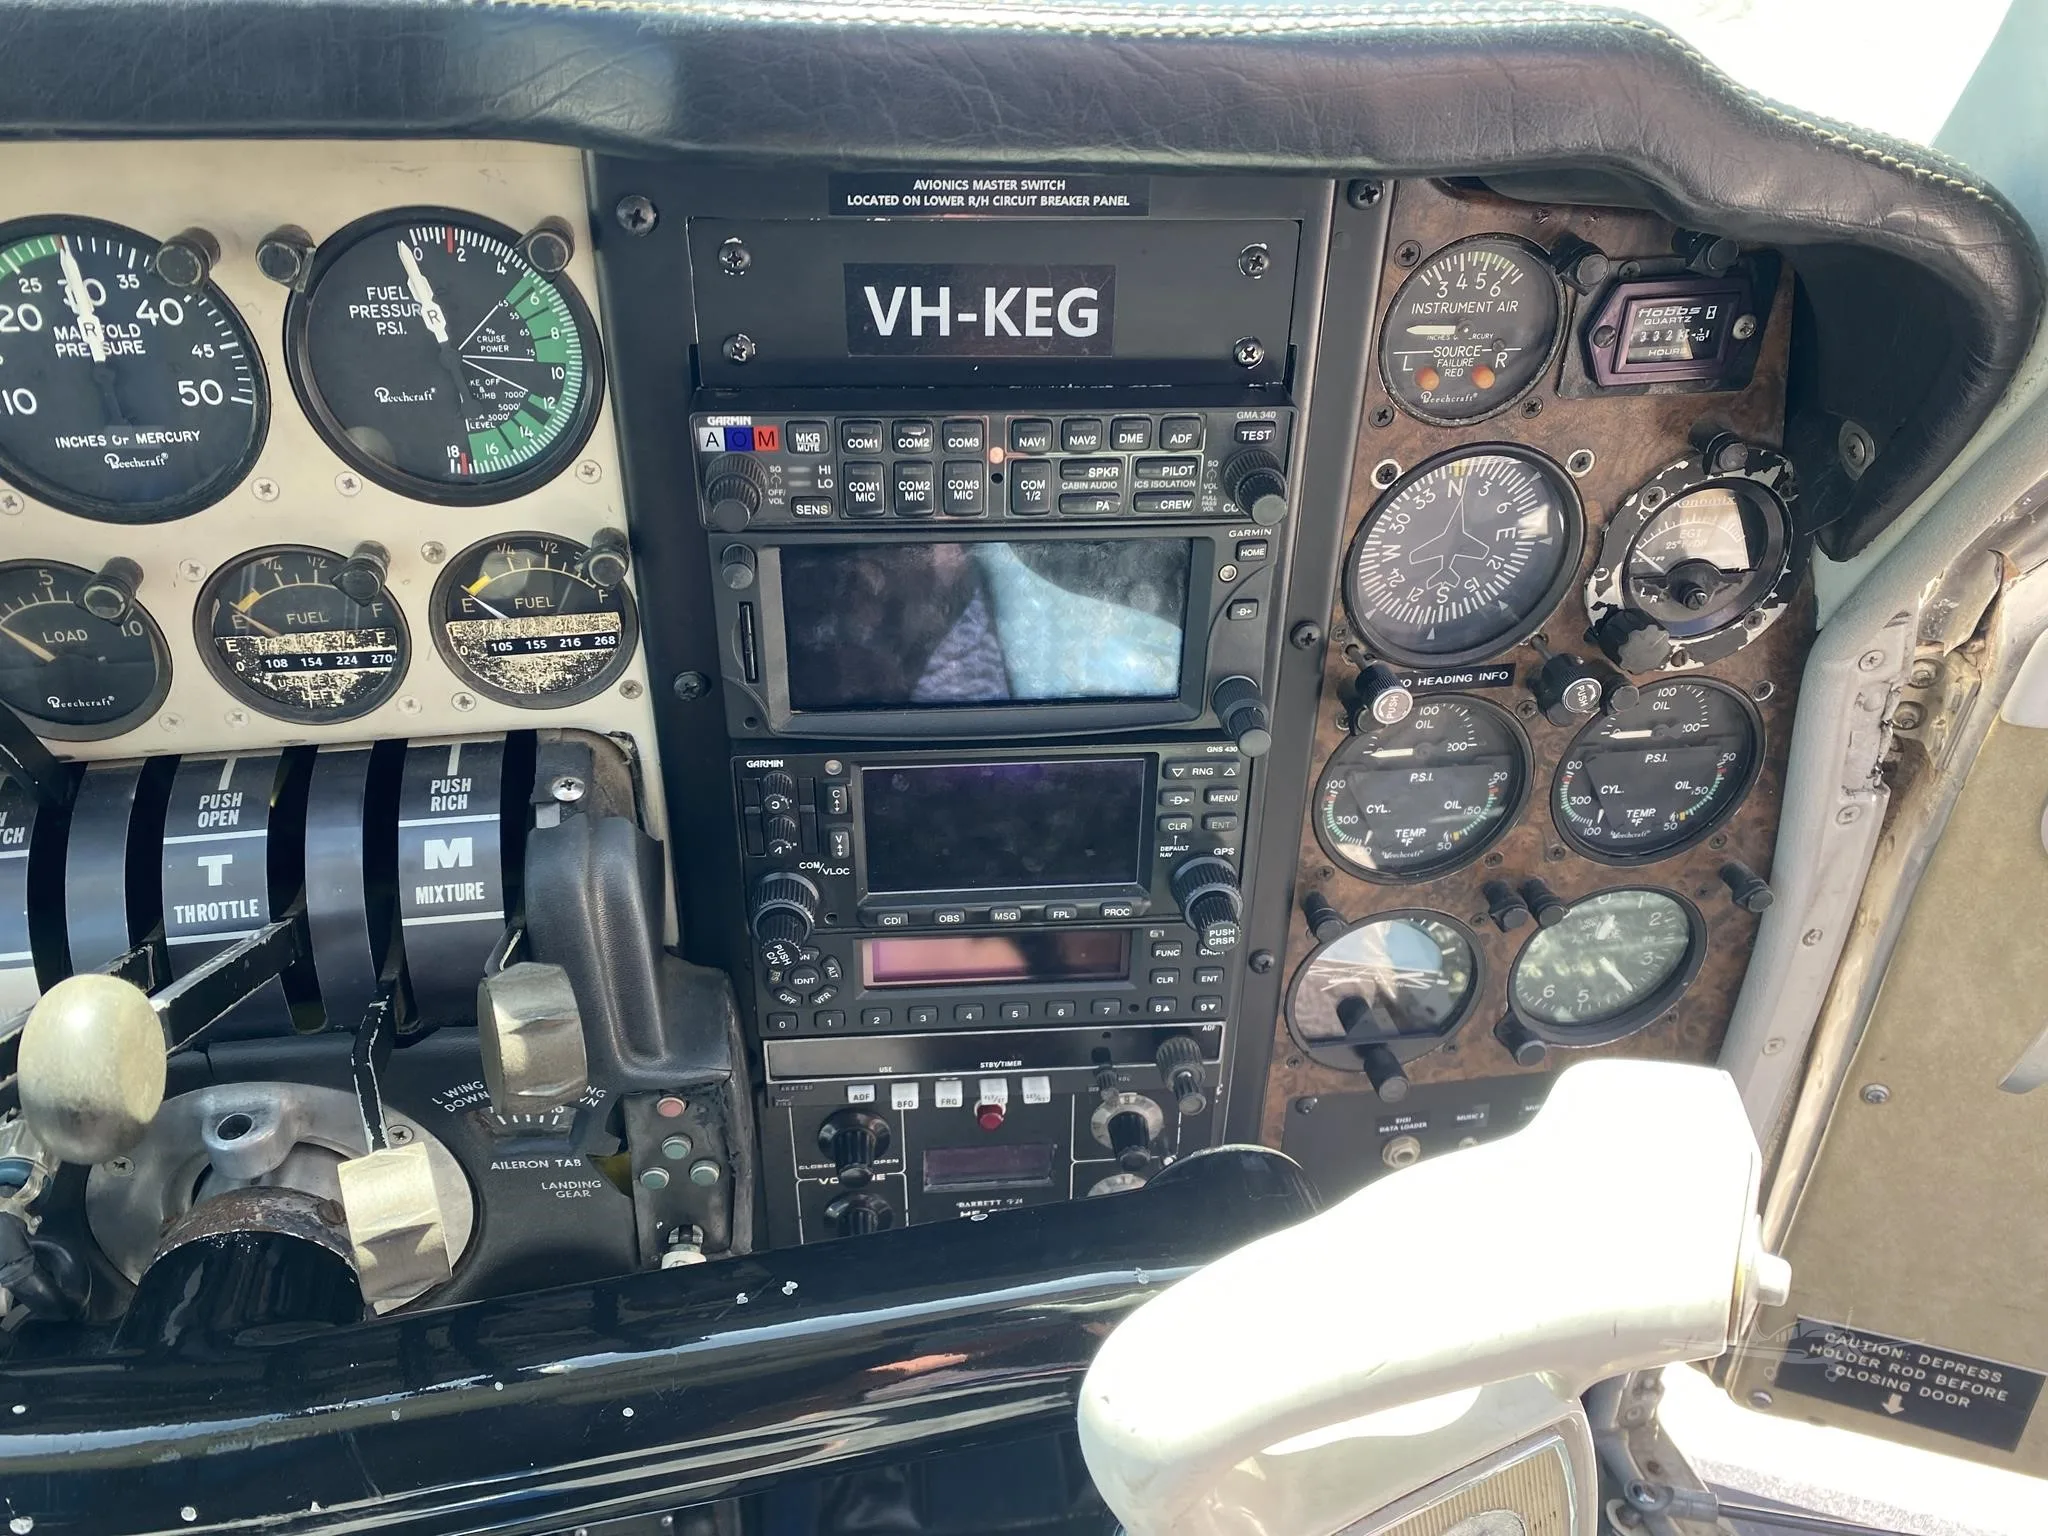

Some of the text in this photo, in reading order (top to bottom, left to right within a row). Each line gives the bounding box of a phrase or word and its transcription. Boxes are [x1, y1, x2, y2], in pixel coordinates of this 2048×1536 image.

[913, 180, 1066, 191] AVIONICS MASTER SWITCH
[847, 195, 1130, 208] LOCATED ON LOWER R/H CIRCUIT BREAKER PANEL
[19, 278, 42, 293] 25
[117, 275, 139, 288] 35
[367, 286, 409, 300] FUEL
[136, 298, 184, 326] 40
[864, 286, 1098, 338] VH-KEG
[1412, 301, 1518, 314] INSTRUMENT AIR
[1639, 306, 1701, 318] Hobbs
[1644, 316, 1692, 325] QUARTZ
[377, 323, 407, 335] P.S.I.
[55, 340, 146, 358] PRESURE
[192, 344, 214, 358] 45
[1433, 346, 1482, 358] SOURCE
[1403, 356, 1413, 371] L
[1437, 358, 1474, 367] FAILURE
[1495, 352, 1507, 368] R
[551, 367, 564, 380] 10
[1445, 369, 1463, 377] RED
[178, 379, 223, 406] 50
[2, 388, 37, 415] 10
[707, 416, 751, 426] GARMIN
[55, 435, 106, 448] INCHES
[136, 431, 201, 444] MERCURY
[706, 433, 774, 447] A O M
[796, 433, 820, 444] MKR
[1069, 436, 1097, 445] NAV2
[1119, 434, 1143, 443] DME
[1170, 434, 1192, 444] ADF
[1241, 430, 1271, 440] TEST
[797, 443, 820, 451] MUTE
[847, 439, 878, 448] COM1
[898, 439, 929, 448] COM2
[948, 438, 979, 447] COM3
[1019, 437, 1046, 447] NAV1
[818, 465, 830, 474] HI
[1088, 467, 1118, 478] SPKR
[1162, 465, 1195, 476] PILOT
[818, 479, 833, 489] LO
[849, 482, 880, 492] COM1
[898, 481, 930, 491] COM2
[948, 480, 979, 490] COM3
[1021, 480, 1045, 490] COM
[1062, 481, 1117, 489] CABIN AUDIO
[1135, 480, 1195, 488] ICS ISOLATION
[1448, 479, 1464, 497] N
[856, 492, 876, 502] MIC
[905, 491, 925, 501] MIC
[954, 490, 973, 500] MIC
[1025, 490, 1041, 501] 1/2
[1413, 489, 1435, 510] 33
[796, 505, 828, 515] SENS
[1096, 501, 1110, 511] PA
[1160, 500, 1192, 510] CREW
[1229, 528, 1272, 537] GARMIN
[1496, 527, 1517, 541] E
[1241, 548, 1265, 556] HOME
[1487, 554, 1505, 570] 12
[515, 597, 555, 609] FUEL
[287, 611, 329, 625] FUEL
[43, 629, 88, 643] LOAD
[460, 636, 616, 655] 0 105 155 216 268
[265, 658, 288, 668] 108
[301, 658, 323, 667] 154
[336, 656, 357, 666] 224
[371, 654, 393, 664] 270
[1653, 702, 1670, 710] OIL
[1415, 721, 1434, 729] OIL
[746, 760, 783, 768] GARMIN
[431, 778, 471, 794] PUSH
[1675, 781, 1691, 790] OIL
[199, 792, 243, 810] PUSH
[431, 794, 467, 811] RICH
[1444, 801, 1462, 809] OIL
[1570, 796, 1591, 805] 300
[198, 809, 239, 828] OPEN
[1336, 816, 1358, 824] 300
[424, 837, 473, 870] M
[198, 854, 232, 886] T
[416, 882, 485, 905] MIXTURE
[174, 899, 259, 924] THROTTLE
[884, 917, 901, 925] CDI
[939, 914, 959, 922] OBS
[1650, 912, 1662, 925] 2
[1209, 929, 1234, 937] PUSH
[1209, 937, 1234, 945] CRSR
[1577, 989, 1589, 1003] 5
[442, 1080, 485, 1099] WING
[1400, 1122, 1427, 1130] LOADER
[491, 1159, 581, 1171] AILERON TAB
[541, 1180, 602, 1190] LANDING
[556, 1190, 591, 1198] GEAR
[1824, 1332, 2003, 1383] CAUTION: DEPRESS
[1809, 1344, 2009, 1402] HOLDER ROD BEFORE
[1834, 1366, 1971, 1409] CLOSING DOOR
